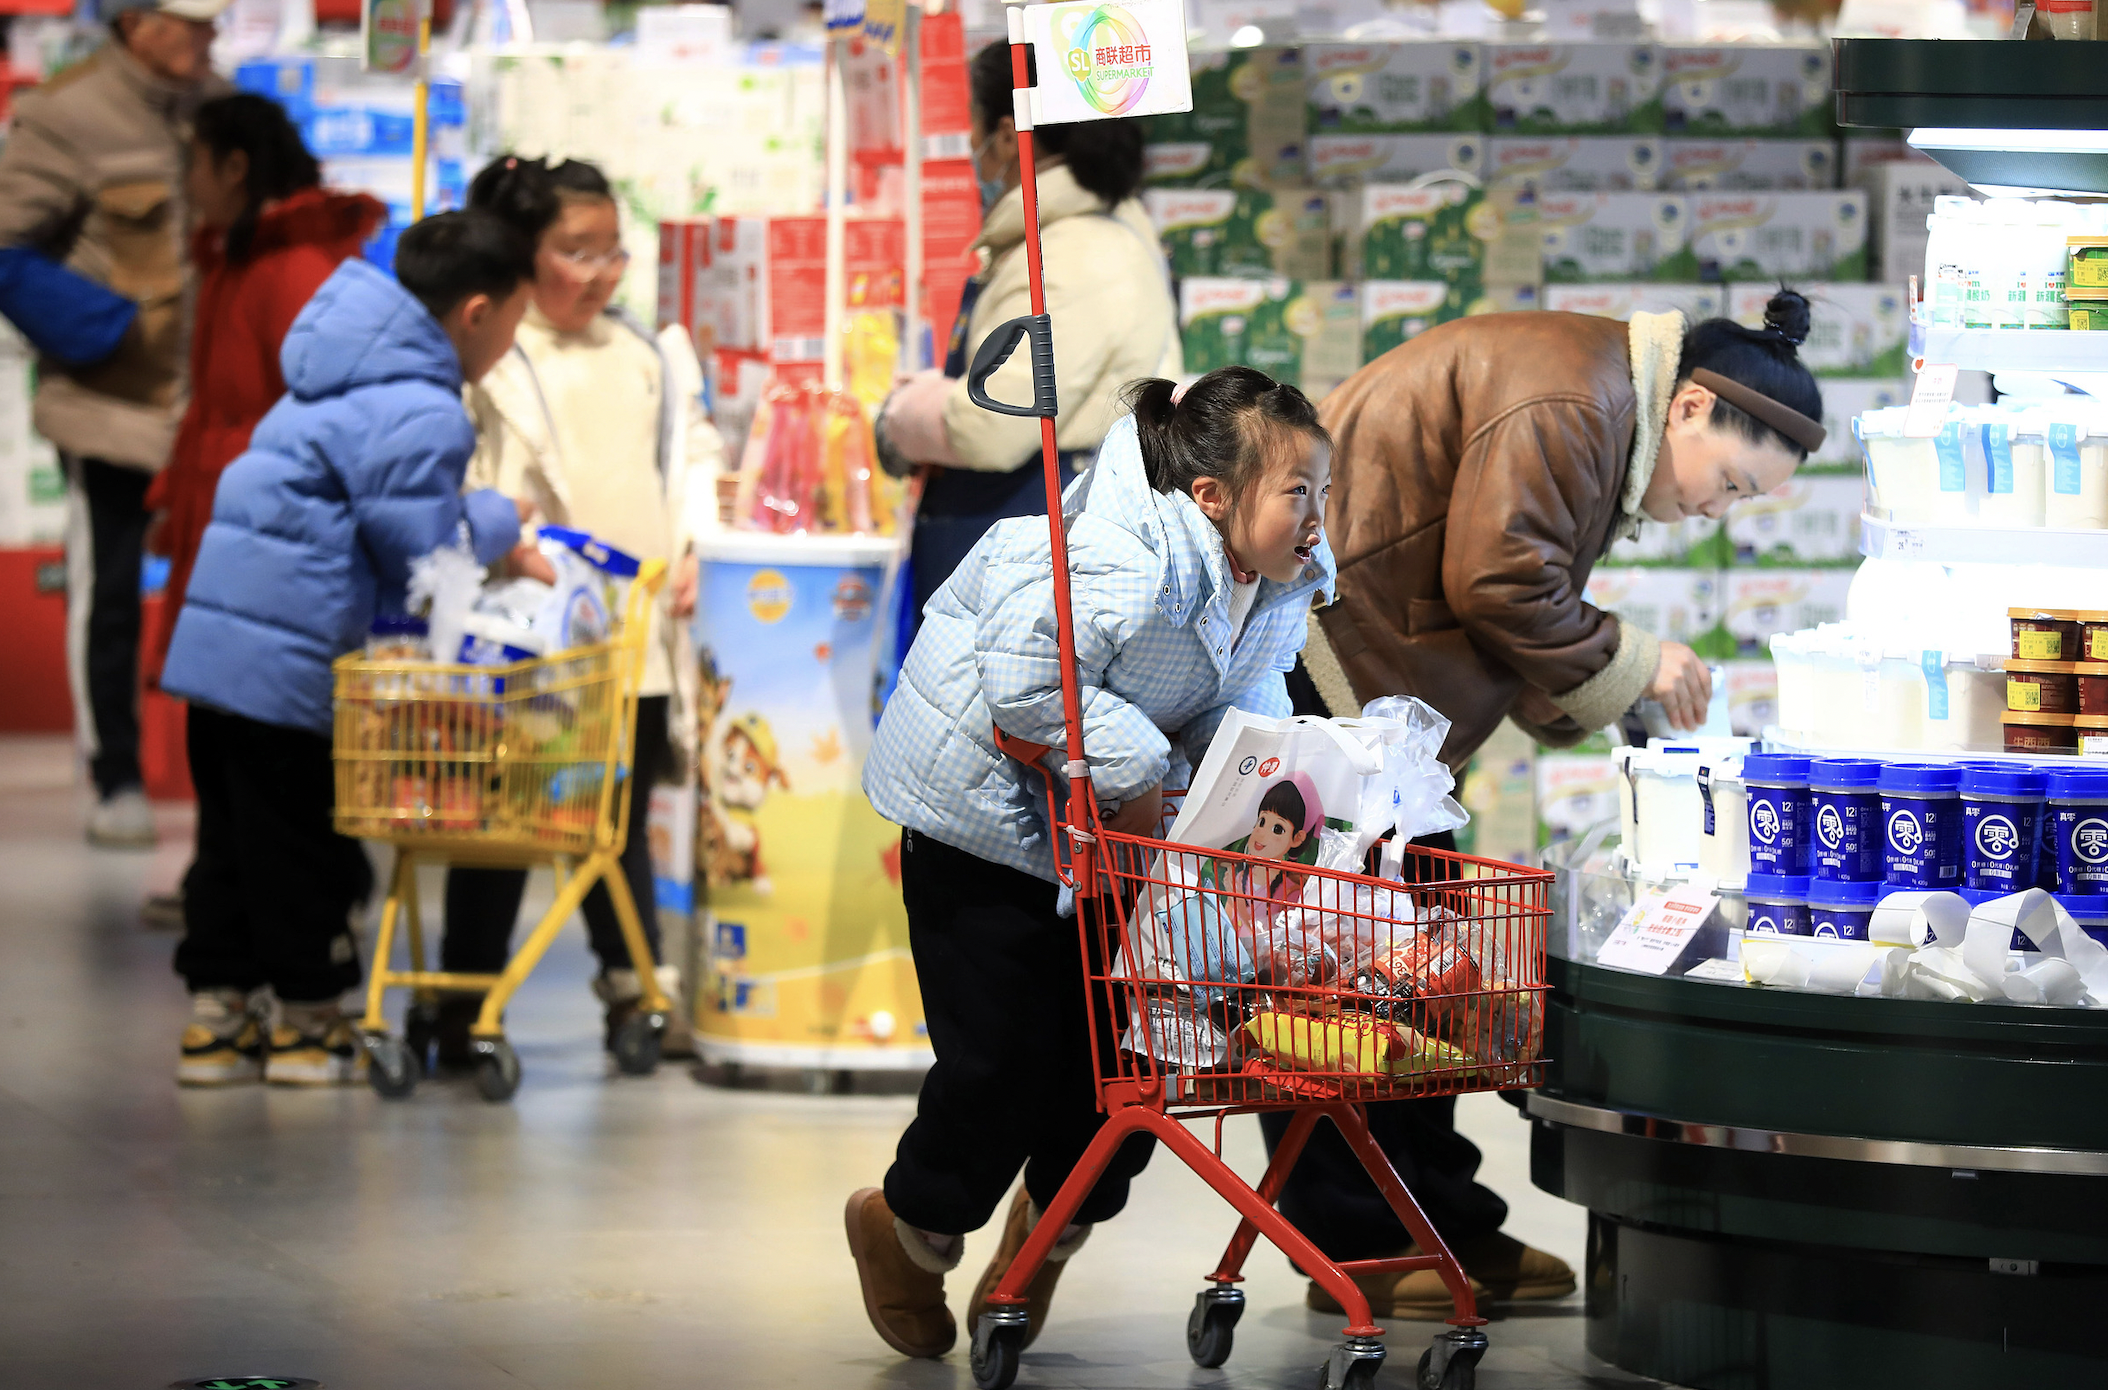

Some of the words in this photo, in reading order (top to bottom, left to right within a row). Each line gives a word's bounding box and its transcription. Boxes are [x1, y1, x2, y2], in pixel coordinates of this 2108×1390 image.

[1070, 53, 1089, 72] SL
[1095, 44, 1151, 66] 商联超市
[1096, 67, 1154, 81] SUPERMARKET
[2080, 829, 2108, 856] 零
[2017, 935, 2026, 945] 12
